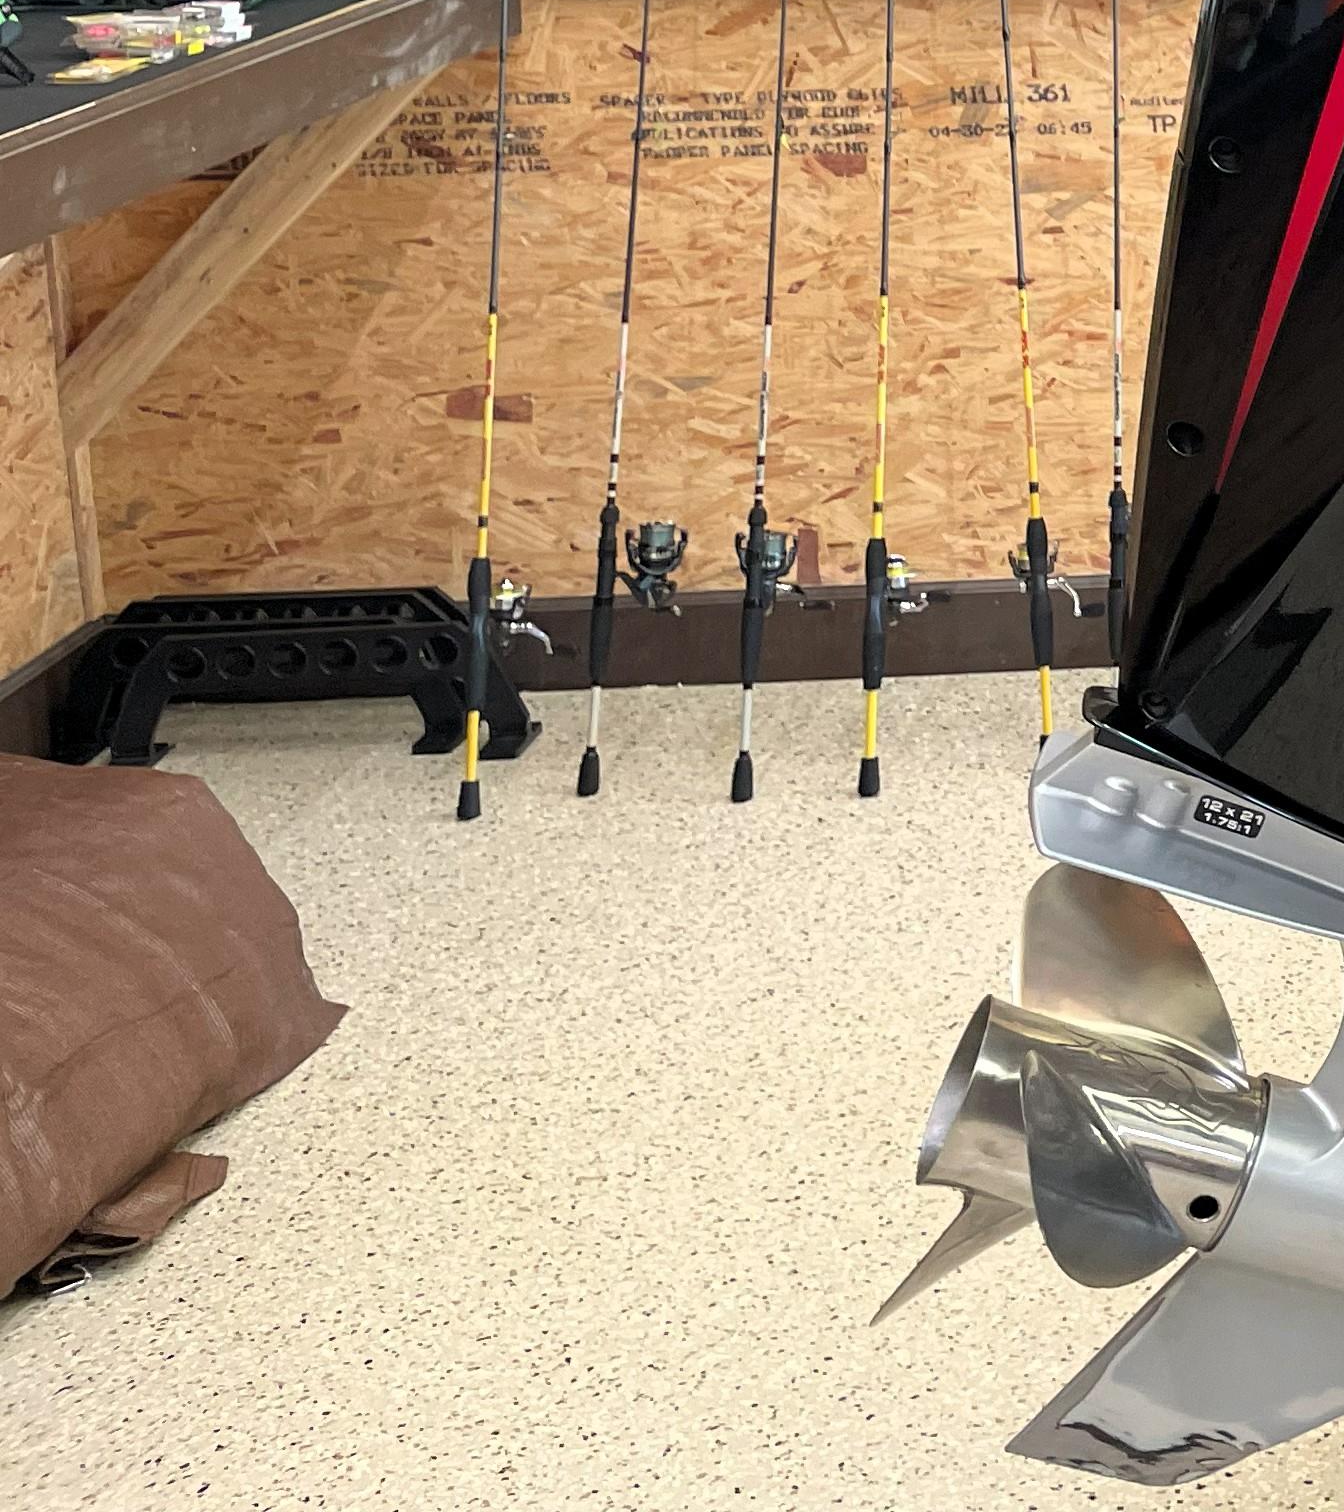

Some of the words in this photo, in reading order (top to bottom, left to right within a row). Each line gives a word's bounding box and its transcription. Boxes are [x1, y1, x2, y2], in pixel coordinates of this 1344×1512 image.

[701, 90, 745, 105] TYPE
[1025, 82, 1073, 103] 361
[1146, 113, 1178, 134] TP
[789, 141, 869, 156] SPACING
[1202, 798, 1223, 813] 12
[1225, 807, 1236, 817] x
[1240, 810, 1263, 826] 21
[1204, 813, 1252, 835] 1.75:1
